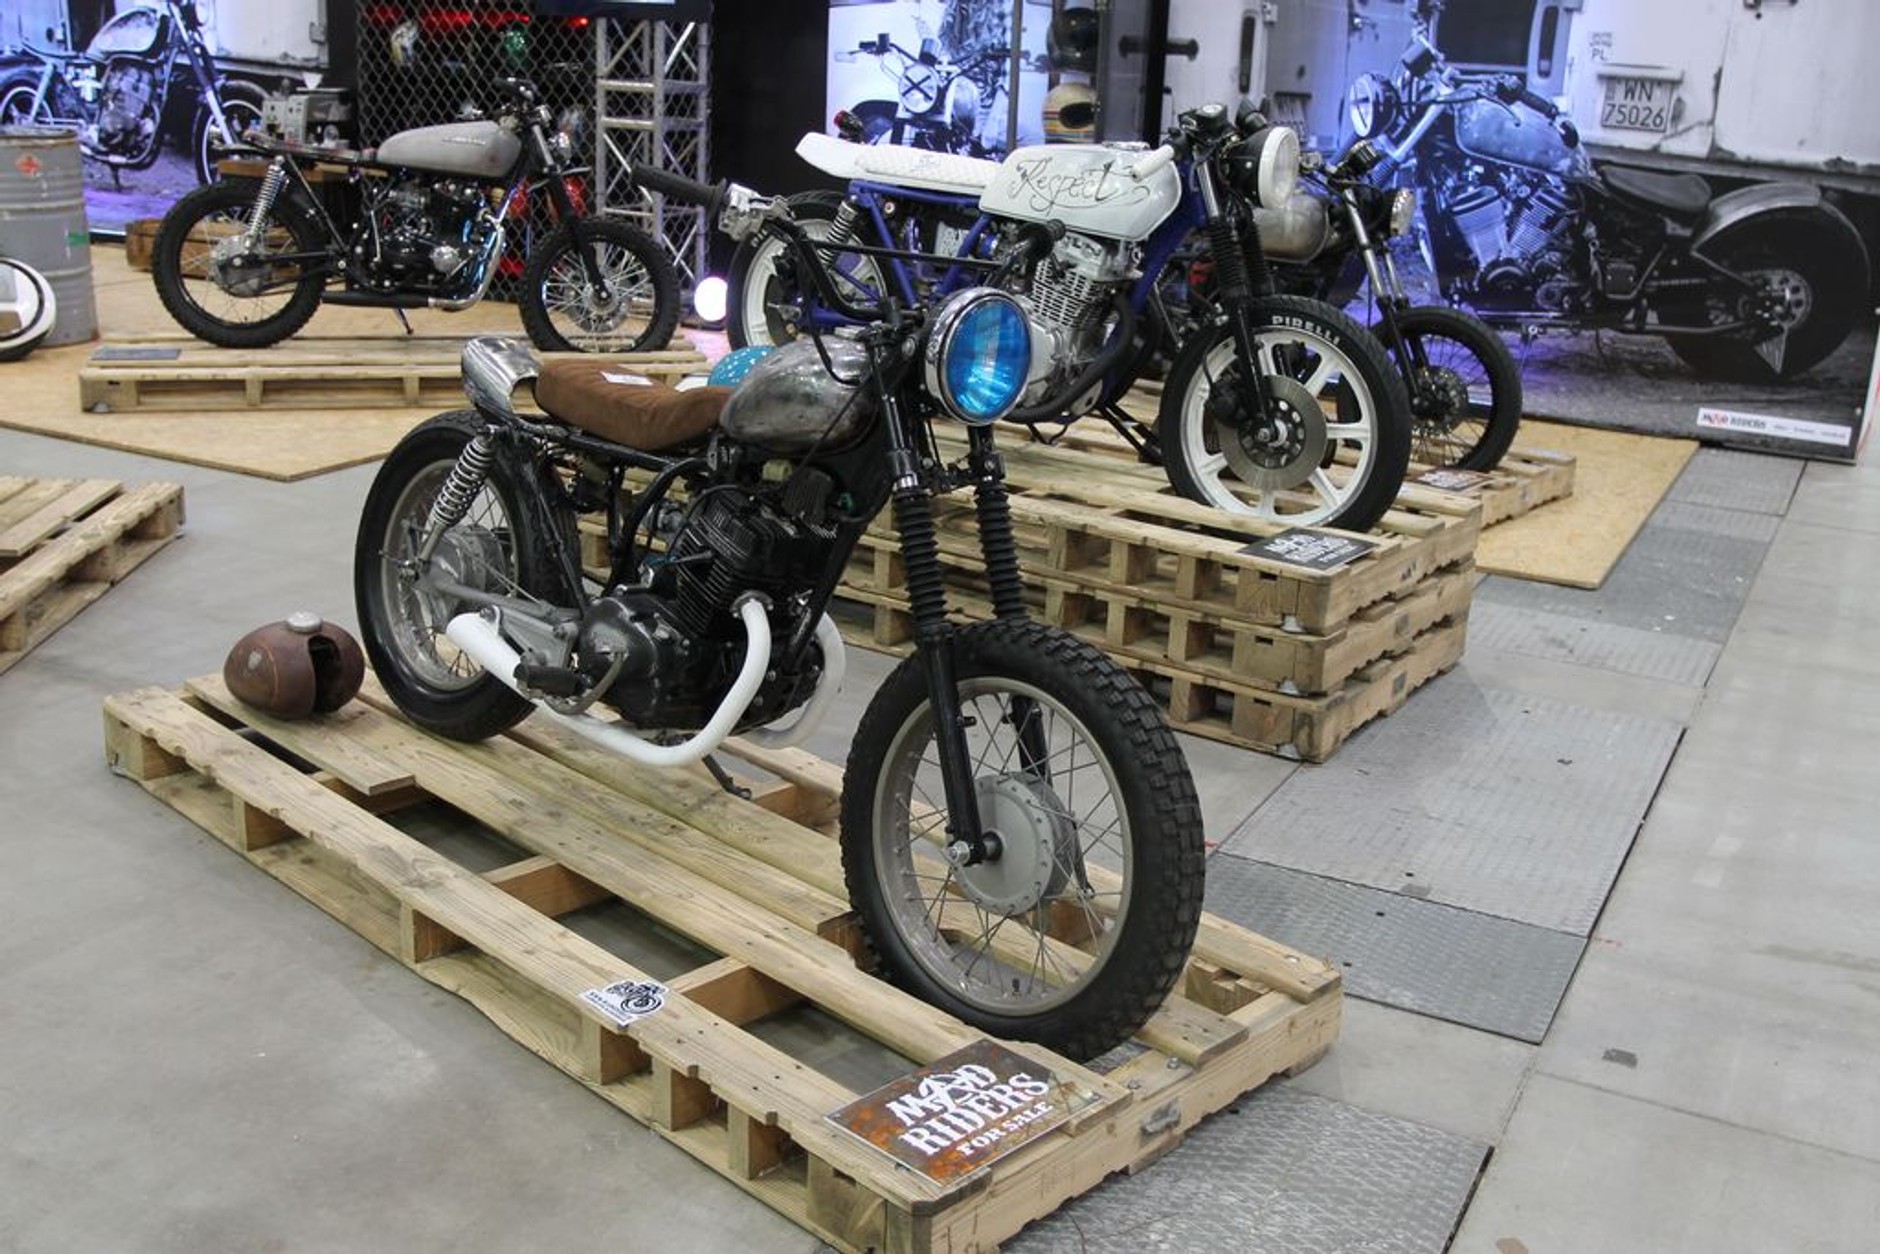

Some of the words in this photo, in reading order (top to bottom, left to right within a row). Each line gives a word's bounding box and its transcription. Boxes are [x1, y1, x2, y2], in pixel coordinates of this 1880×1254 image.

[1591, 48, 1607, 60] PL
[1623, 78, 1655, 101] WN
[1603, 102, 1664, 128] 75026
[1009, 157, 1142, 216] Respect
[1272, 315, 1340, 345] PIRELLI
[886, 1064, 998, 1127] MAD
[901, 1073, 1049, 1156] RIDERS
[957, 1128, 1005, 1157] FOR
[1003, 1102, 1052, 1132] SALE
